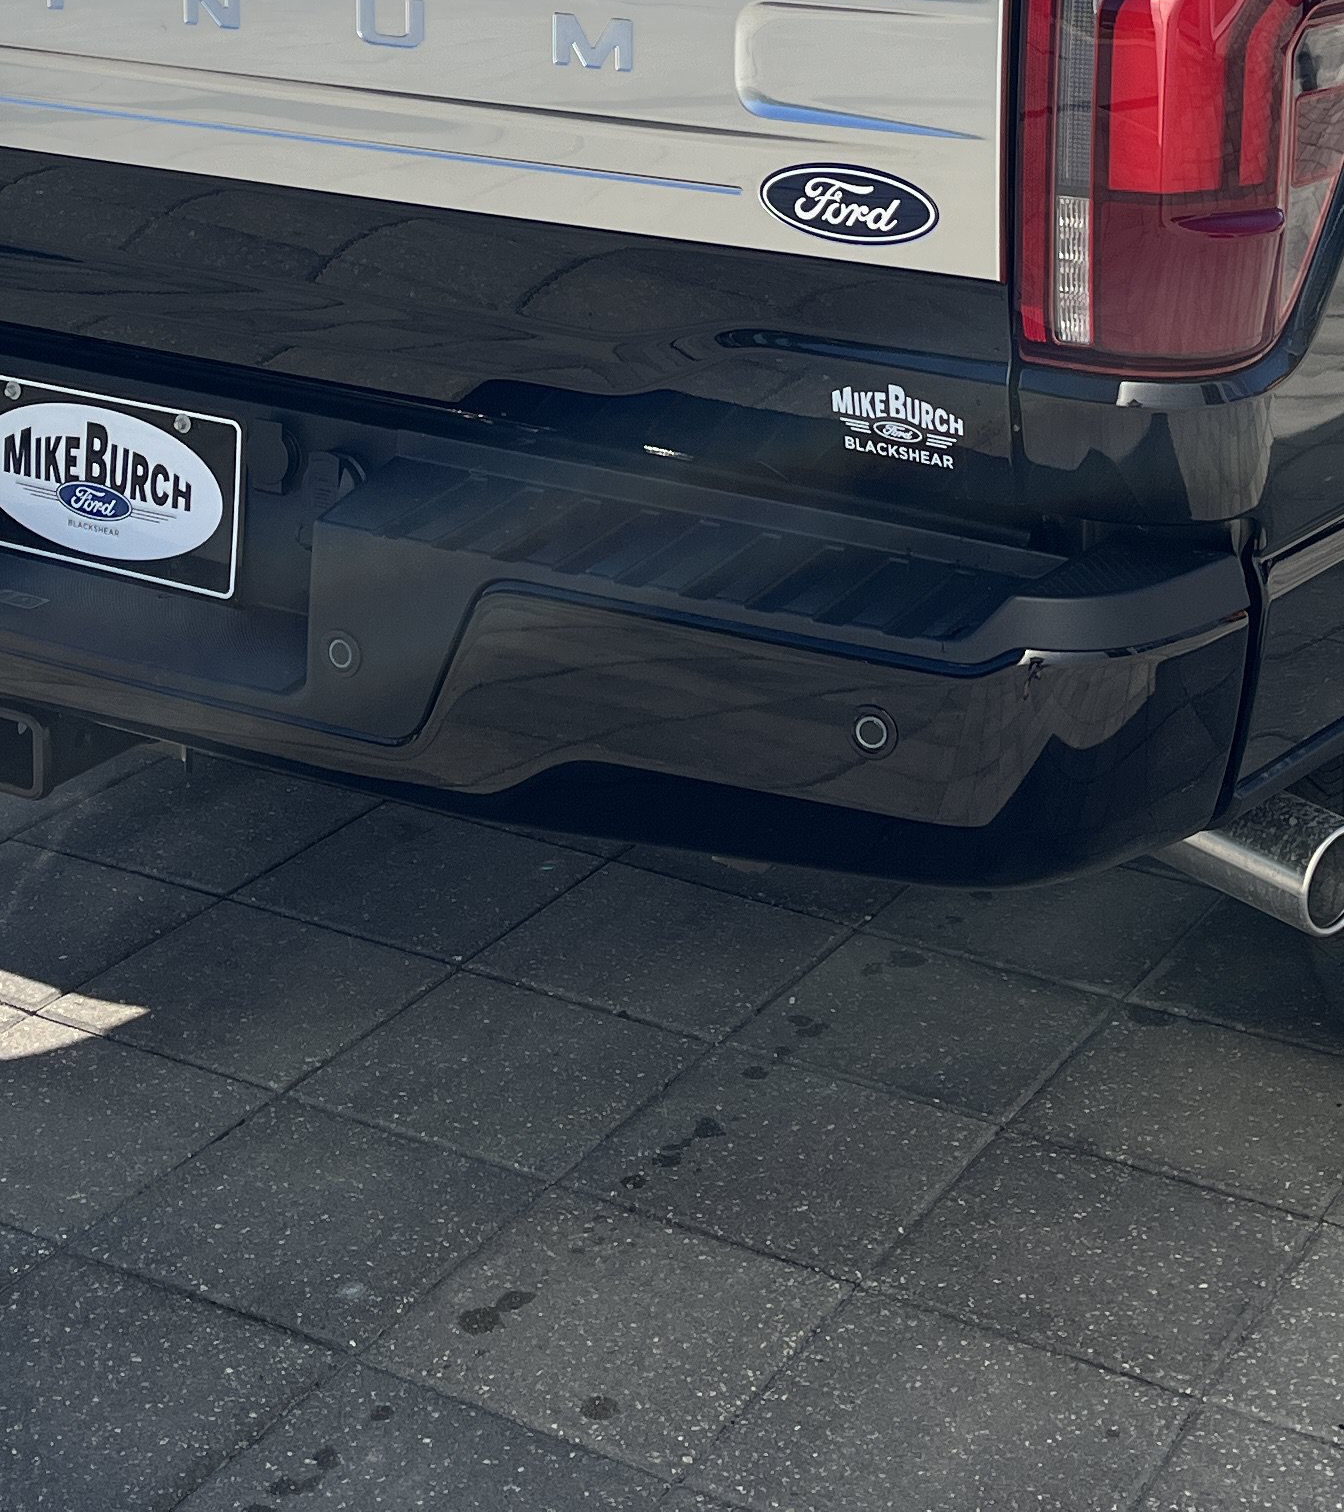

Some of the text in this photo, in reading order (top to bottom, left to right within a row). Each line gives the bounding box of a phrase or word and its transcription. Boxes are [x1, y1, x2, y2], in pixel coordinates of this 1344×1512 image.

[794, 177, 901, 233] Ford
[882, 424, 913, 440] Ford
[844, 436, 954, 470] BLACKSHEAR
[70, 486, 116, 517] Ford
[67, 519, 120, 537] BLACKSHEAR
